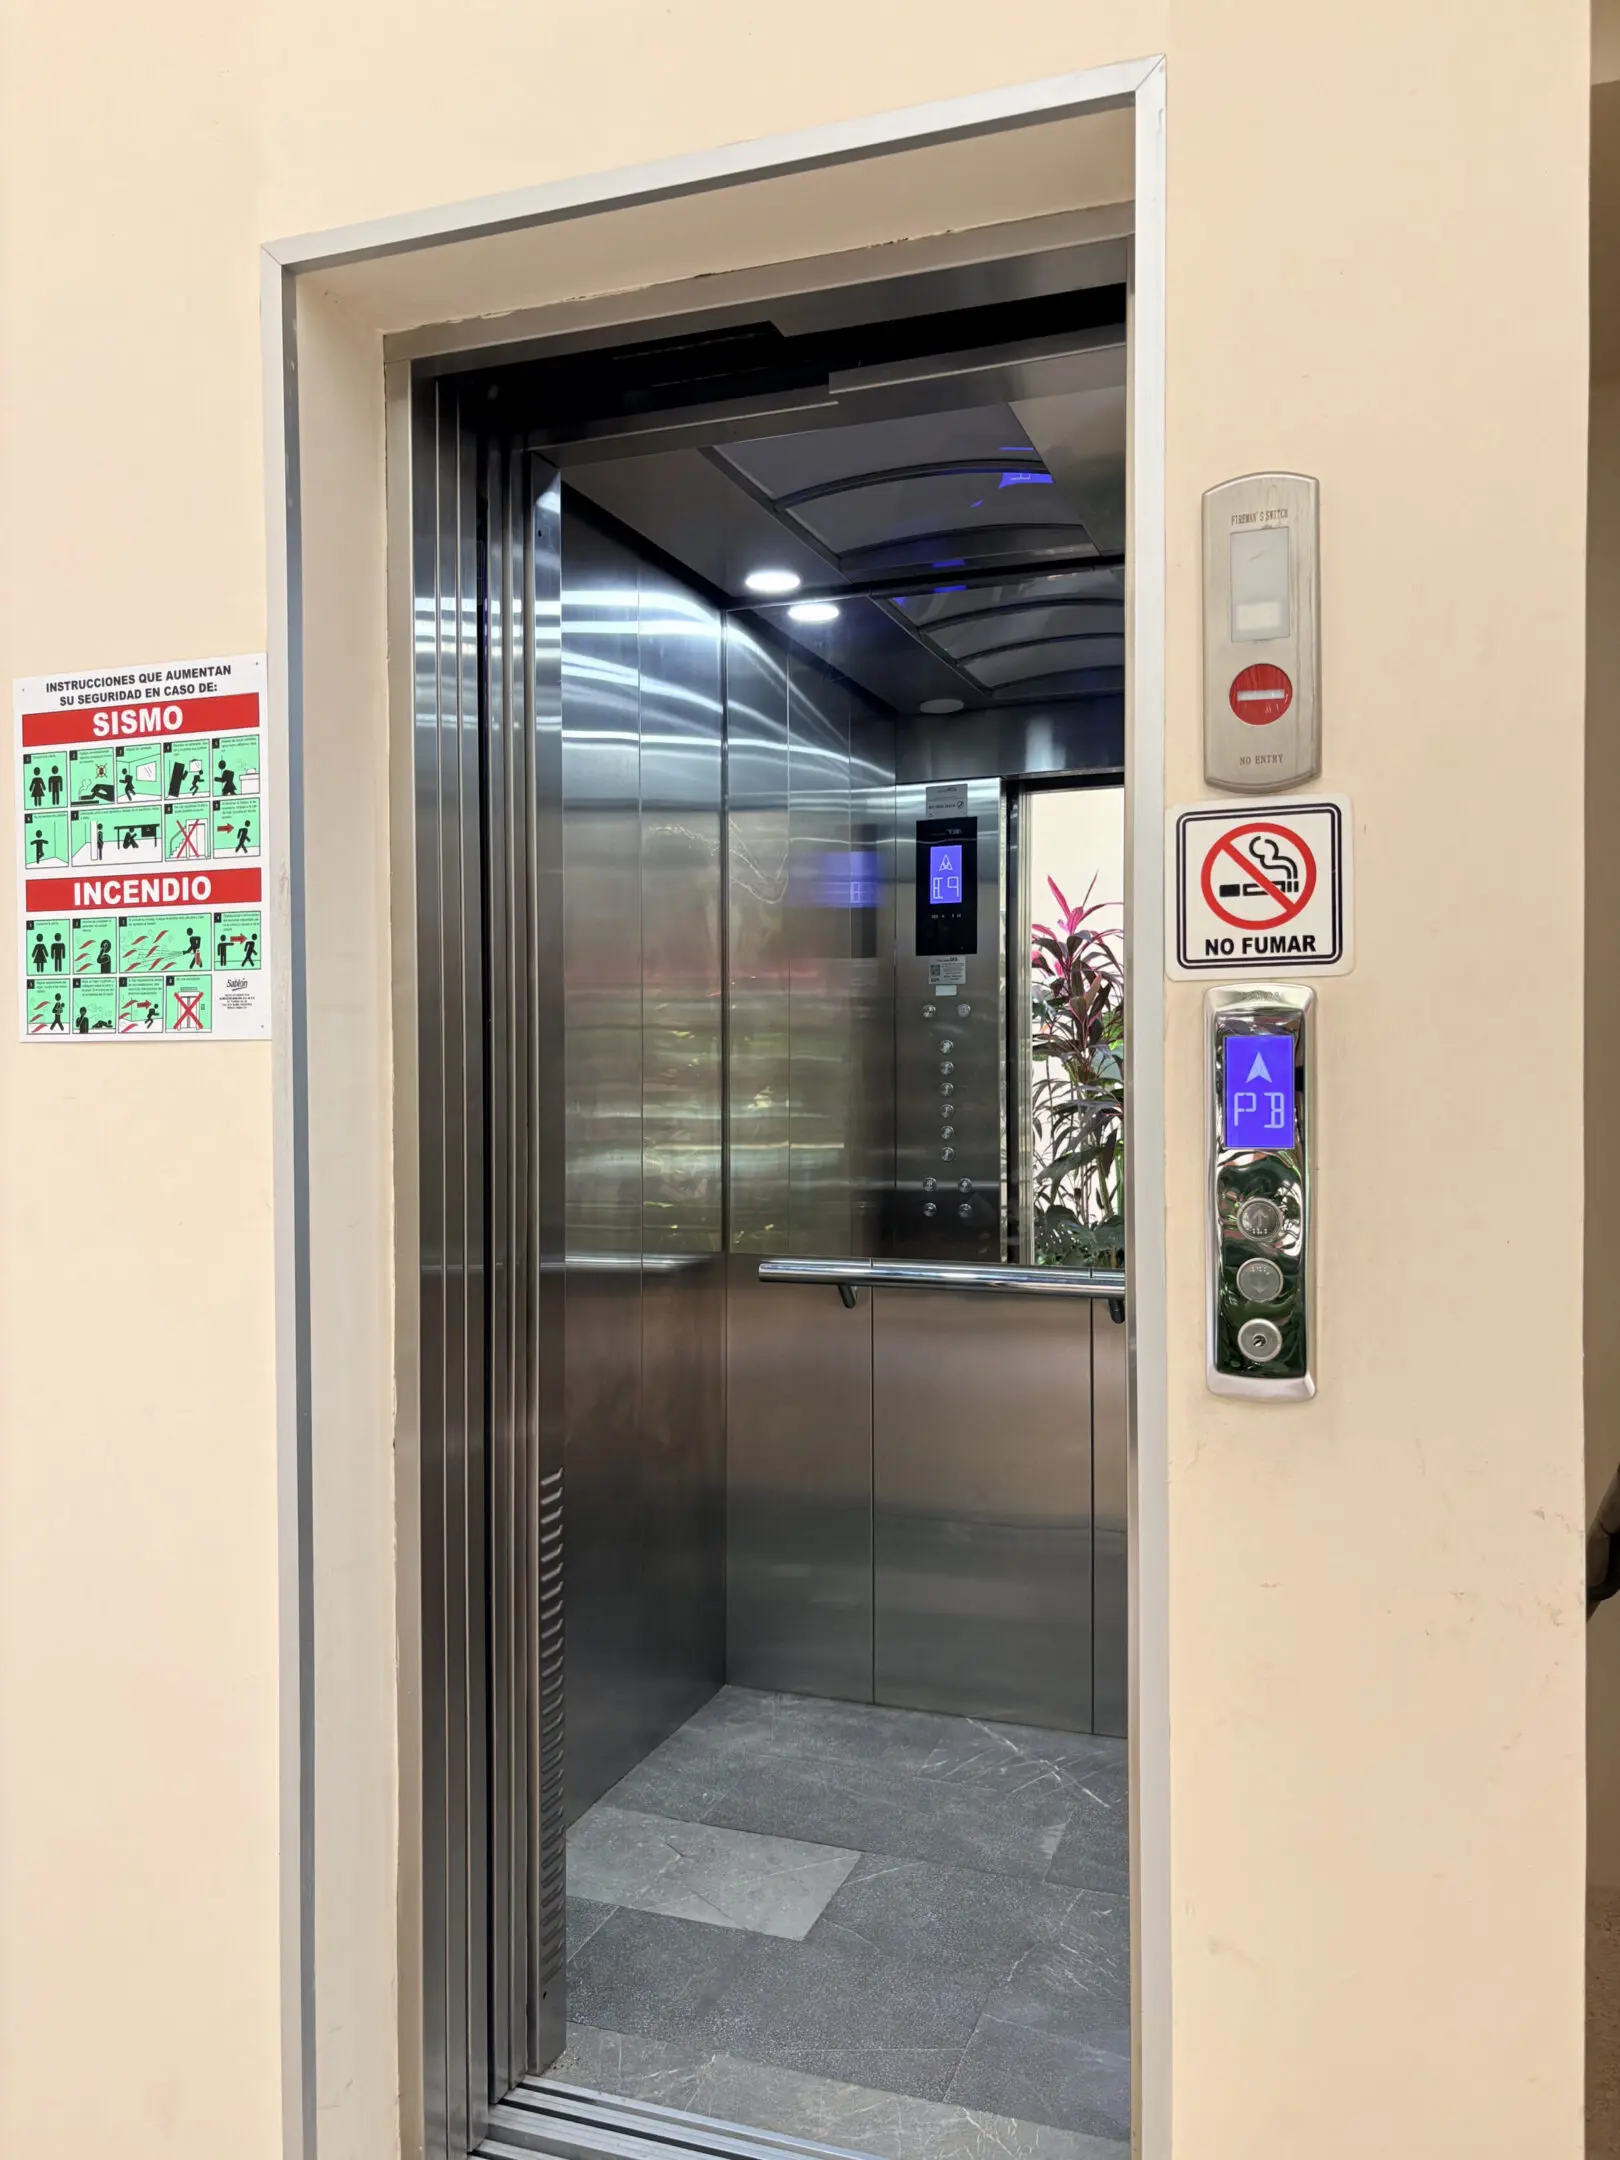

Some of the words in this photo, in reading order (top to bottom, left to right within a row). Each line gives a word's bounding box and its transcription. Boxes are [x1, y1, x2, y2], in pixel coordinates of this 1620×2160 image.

[46, 675, 135, 692] INSTRUCCIONES
[139, 671, 163, 684] QUE
[166, 665, 232, 681] AUMENTAN
[59, 696, 75, 706] SU
[78, 687, 142, 704] SEGURIDAD
[145, 687, 161, 698] EN
[164, 683, 195, 697] CASO
[199, 682, 218, 693] DE:
[93, 705, 184, 737] SISMO
[1240, 756, 1251, 766] NO
[1255, 754, 1283, 765] ENTRY
[74, 876, 211, 906] INCENDIO
[1205, 938, 1234, 956] NO
[1242, 935, 1316, 955] FUMAR
[1234, 1092, 1285, 1129] PB
